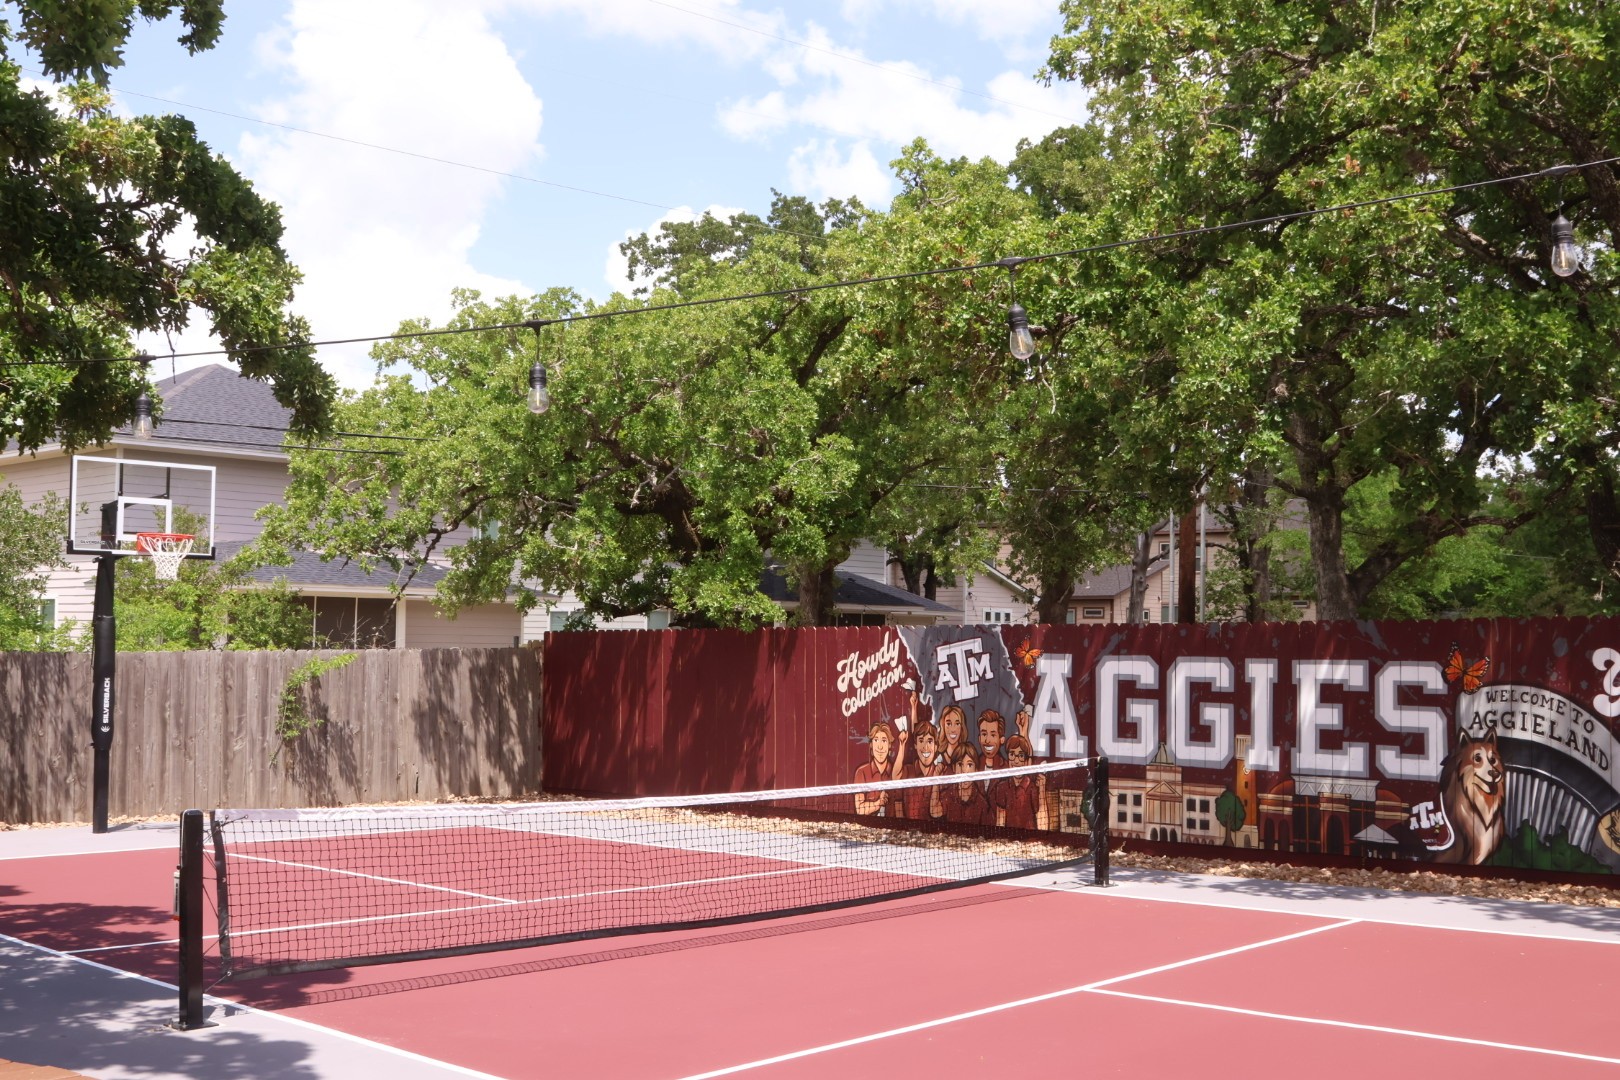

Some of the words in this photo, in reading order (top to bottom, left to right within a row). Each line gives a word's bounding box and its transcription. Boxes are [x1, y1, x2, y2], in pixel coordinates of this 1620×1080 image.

[837, 632, 899, 693] Howdy
[1026, 653, 1449, 782] AGGIES
[1469, 711, 1609, 771] AGGIELAND
[1486, 690, 1567, 716] WELCOME
[1572, 707, 1595, 734] TO
